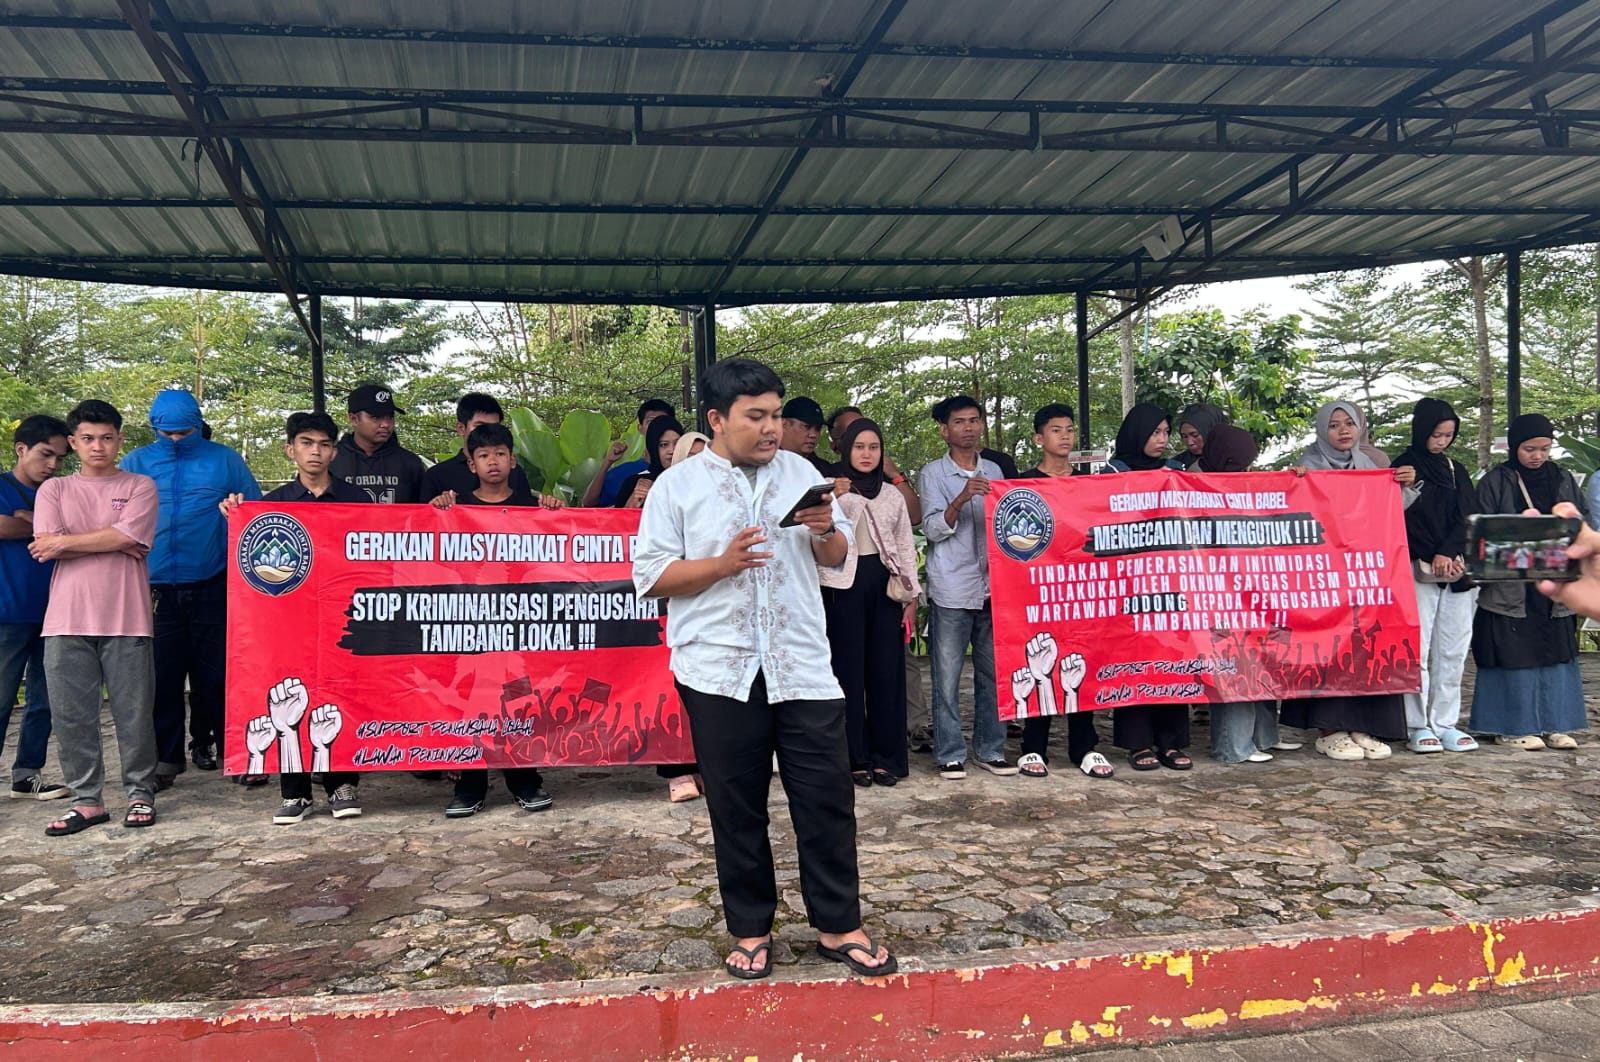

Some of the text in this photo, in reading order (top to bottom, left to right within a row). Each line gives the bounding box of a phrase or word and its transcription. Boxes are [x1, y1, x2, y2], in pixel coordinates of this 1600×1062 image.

[1109, 492, 1158, 513] GERAKAN
[1160, 490, 1226, 509] MASYARAKAT
[1255, 491, 1289, 510] BABEL
[345, 532, 434, 561] GERAKAN
[439, 533, 568, 562] MASYARAKAT
[572, 535, 624, 562] CINTA
[1093, 520, 1183, 551] MENGECAM
[1184, 520, 1212, 545] DAN
[1215, 521, 1293, 545] MENGUTUK
[1029, 551, 1385, 584] TINDAKAN PEMERASAN DAN INTIMIDASI YANG
[1040, 579, 1127, 603] DILAKUKAN
[1133, 574, 1169, 594] OLEH
[1179, 573, 1225, 592] OKNUM
[1233, 573, 1289, 591] SATGAS
[1309, 572, 1340, 589] LSM
[1348, 570, 1379, 588] DAN
[353, 592, 659, 621] STOP KRIMINALISASI PENGUSAHA
[1026, 588, 1393, 623] WARTAWAN BODONG KEPADA PENGUSAHA LOKAL
[1133, 613, 1209, 632] TAMBANG
[1214, 611, 1266, 630] RAKYAT
[420, 623, 596, 652] TAMBANG LOKAL !!!
[356, 720, 428, 738] #SUPPORT
[353, 745, 405, 766] #LAWAN
